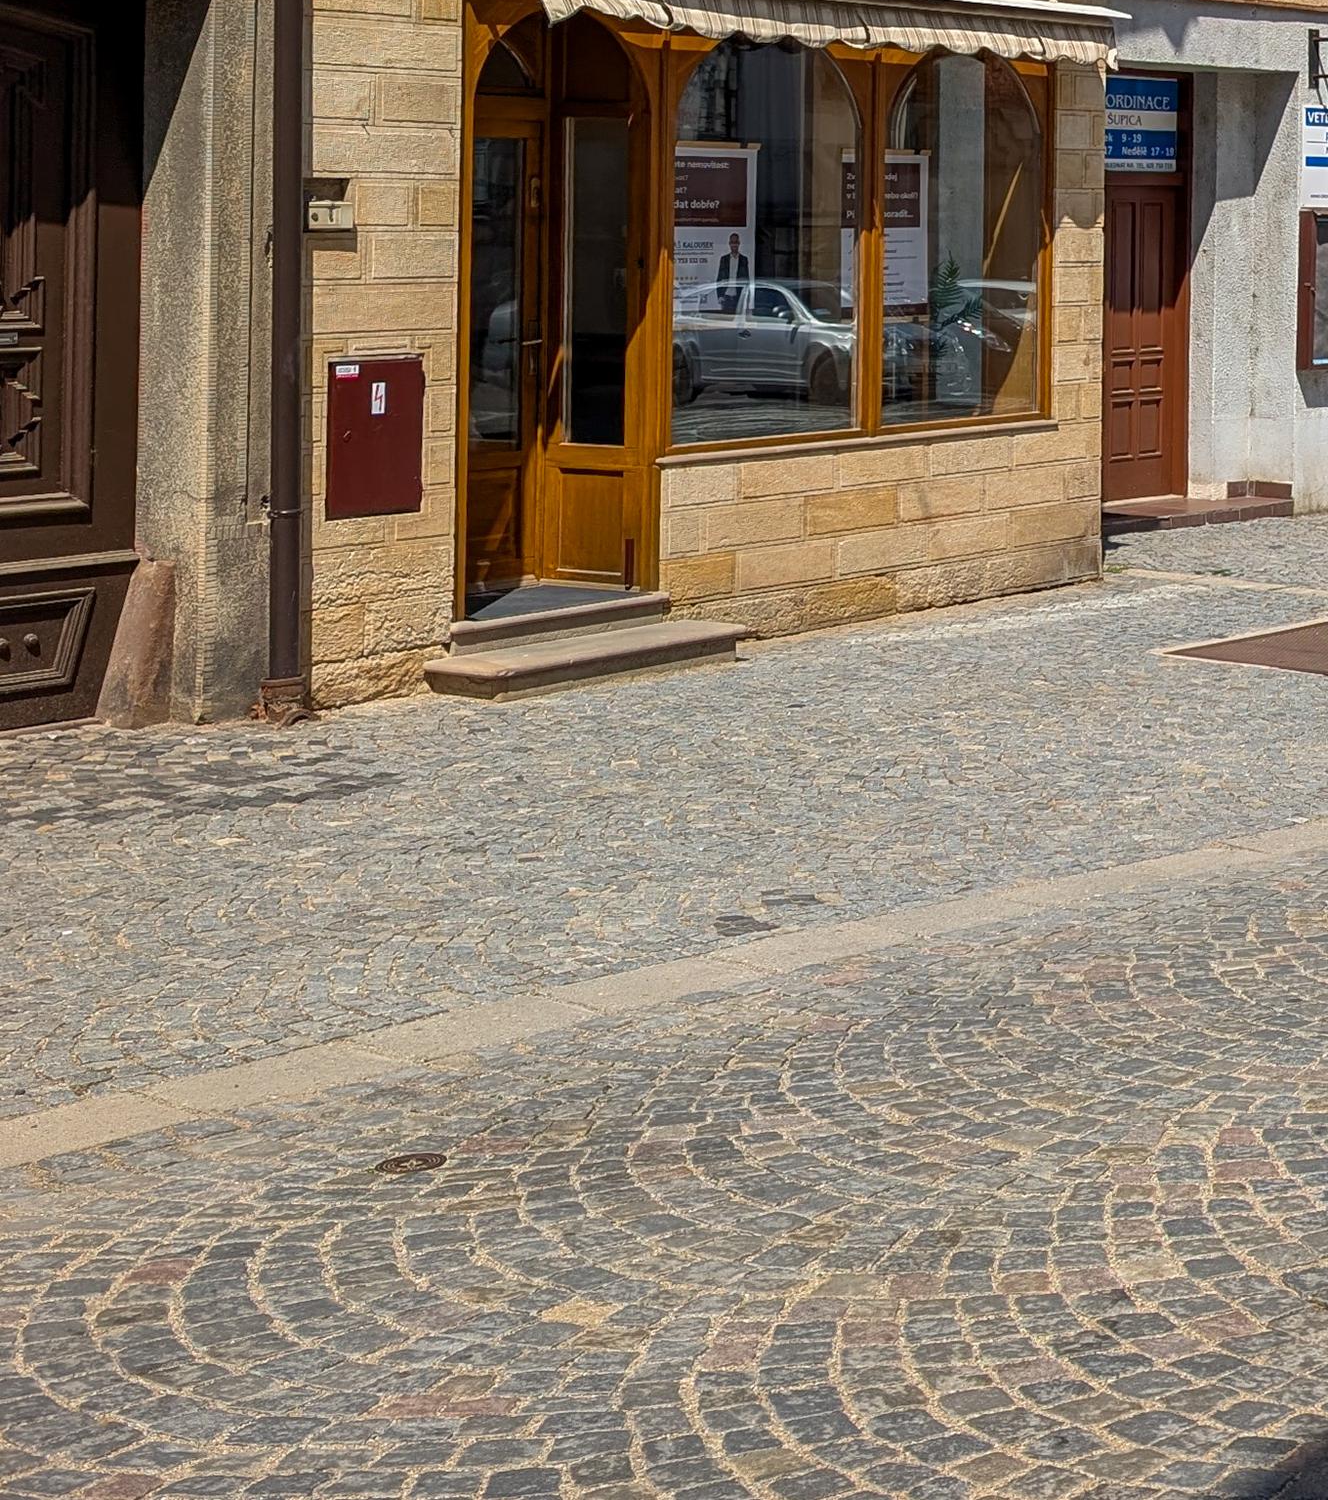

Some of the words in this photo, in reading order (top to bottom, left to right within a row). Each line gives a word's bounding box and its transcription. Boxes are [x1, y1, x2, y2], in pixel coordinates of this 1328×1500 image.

[1106, 93, 1170, 110] ORDINACE
[1107, 112, 1142, 126] ŠUPICA
[690, 200, 720, 209] dobře?
